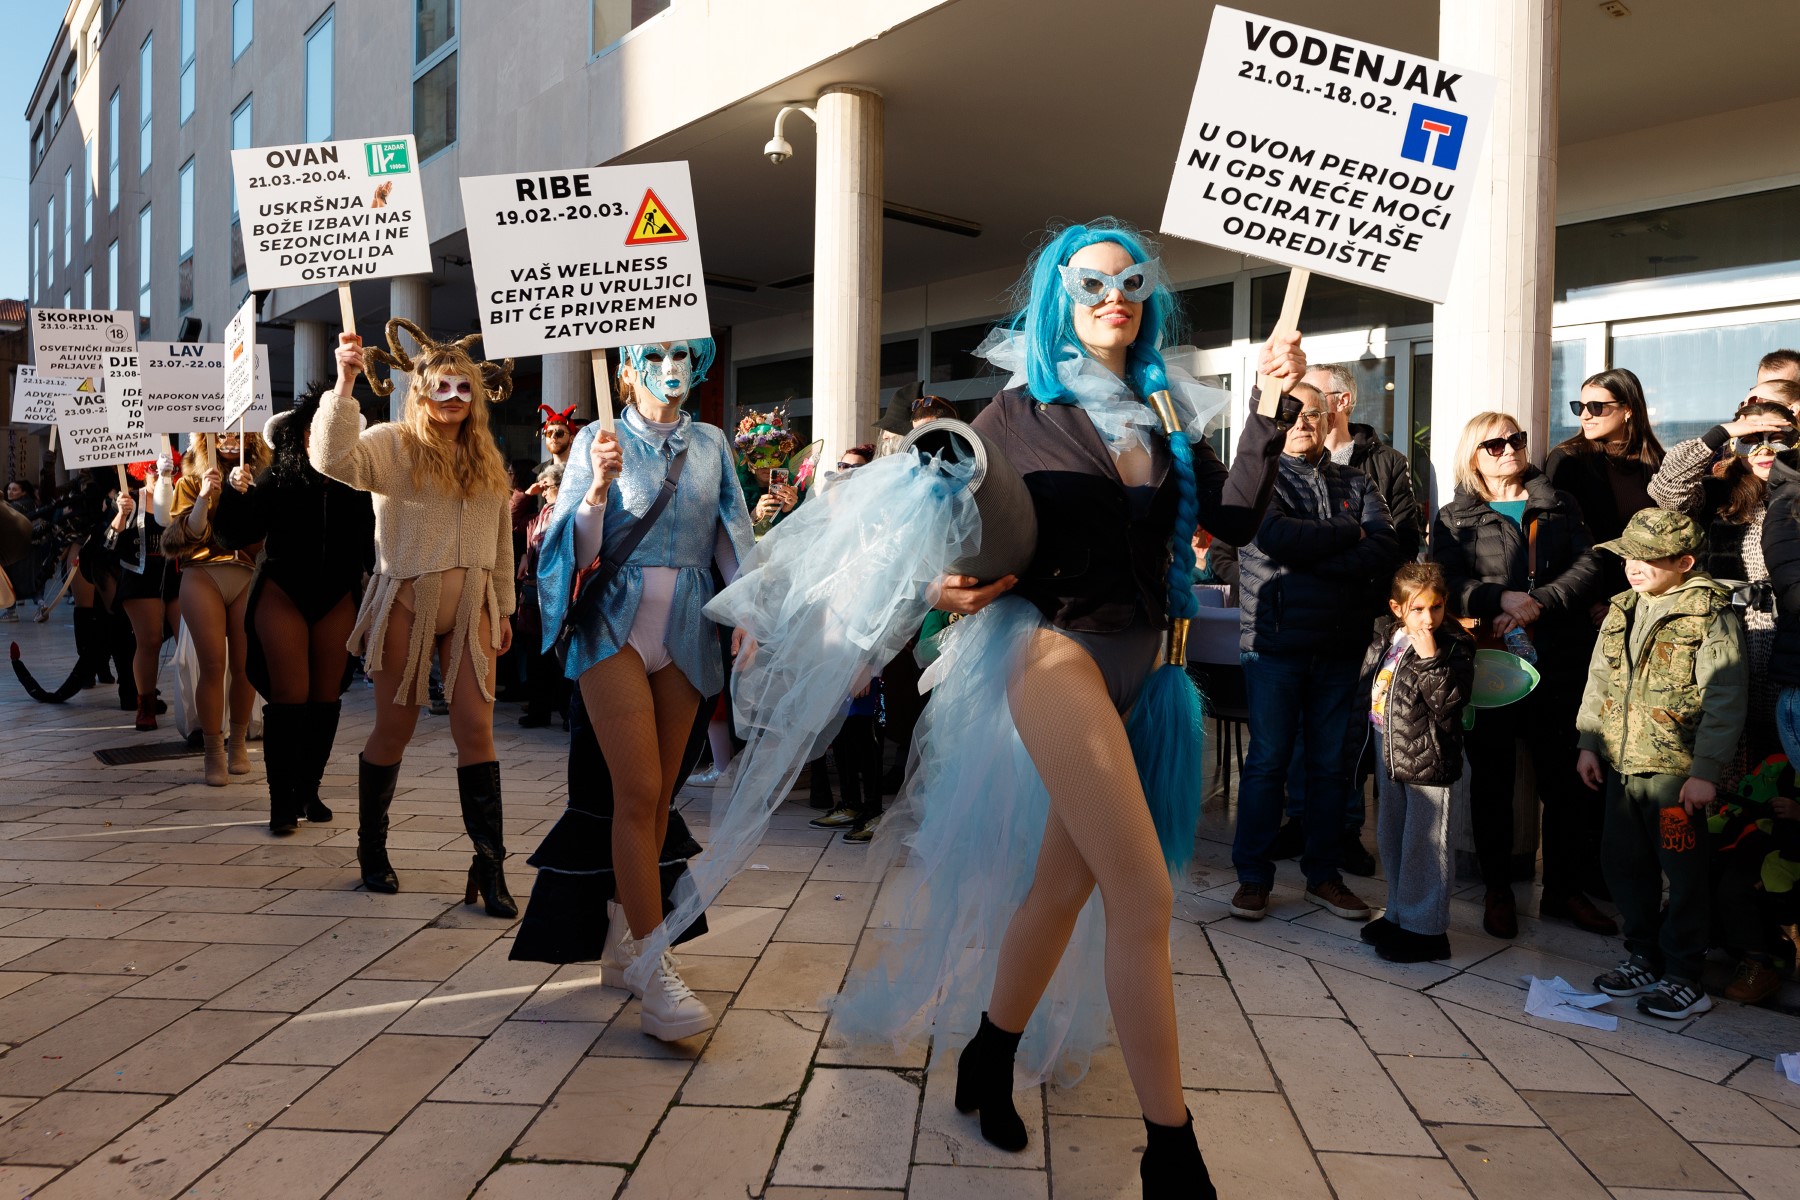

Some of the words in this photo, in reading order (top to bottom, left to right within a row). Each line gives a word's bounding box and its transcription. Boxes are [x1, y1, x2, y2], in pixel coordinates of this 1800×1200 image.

[1245, 20, 1463, 103] VODENJAK
[1238, 60, 1398, 116] 21.01.-18.02.
[266, 145, 339, 169] OVAN
[383, 143, 405, 151] ZADAR
[1199, 122, 1221, 142] U
[1225, 130, 1316, 167] OVOM
[1319, 153, 1455, 201] PERIODU
[248, 170, 351, 189] 21.03.-20.04.
[515, 173, 592, 202] RIBE
[1187, 148, 1221, 172] NI
[1226, 159, 1285, 188] GPS
[1288, 174, 1369, 209] NEĆE
[1371, 195, 1452, 230] MOĆI
[259, 194, 364, 217] USKRŠNJA
[495, 202, 629, 226] 19.02.-20.03.
[1202, 181, 1341, 231] LOCIRATI
[1349, 217, 1424, 253] VAŠE
[253, 219, 303, 237] BOŽE
[308, 214, 370, 231] IZBAVI
[375, 210, 412, 225] NAS
[259, 230, 371, 252] SEZONCIMA
[375, 229, 380, 241] I
[385, 226, 409, 240] NE
[1223, 216, 1392, 273] ODREDIŠTE
[280, 247, 363, 267] DOZVOLI
[368, 244, 394, 258] DA
[301, 261, 377, 281] OSTANU
[510, 262, 552, 283] VAŠ
[557, 256, 668, 279] WELLNESS
[490, 284, 575, 305] CENTAR
[580, 282, 594, 297] U
[598, 273, 692, 295] VRULJICI
[37, 310, 114, 323] ŠKORPION
[490, 308, 524, 325] BIT
[529, 303, 555, 321] ĆE
[561, 292, 698, 318] PRIVREMENO
[109, 328, 124, 339] 18
[544, 315, 656, 340] ZATVOREN
[39, 344, 102, 352] OSVETNIČKI
[169, 344, 204, 357] LAV
[109, 356, 138, 367] DJE
[149, 360, 225, 368] 23.07.-22.08.
[73, 394, 105, 406] VAG
[166, 404, 193, 412] GOST
[128, 410, 142, 418] 10
[74, 435, 113, 445] VRATA
[92, 441, 138, 452] DRAGIM
[78, 448, 154, 462] STUDENTIMA
